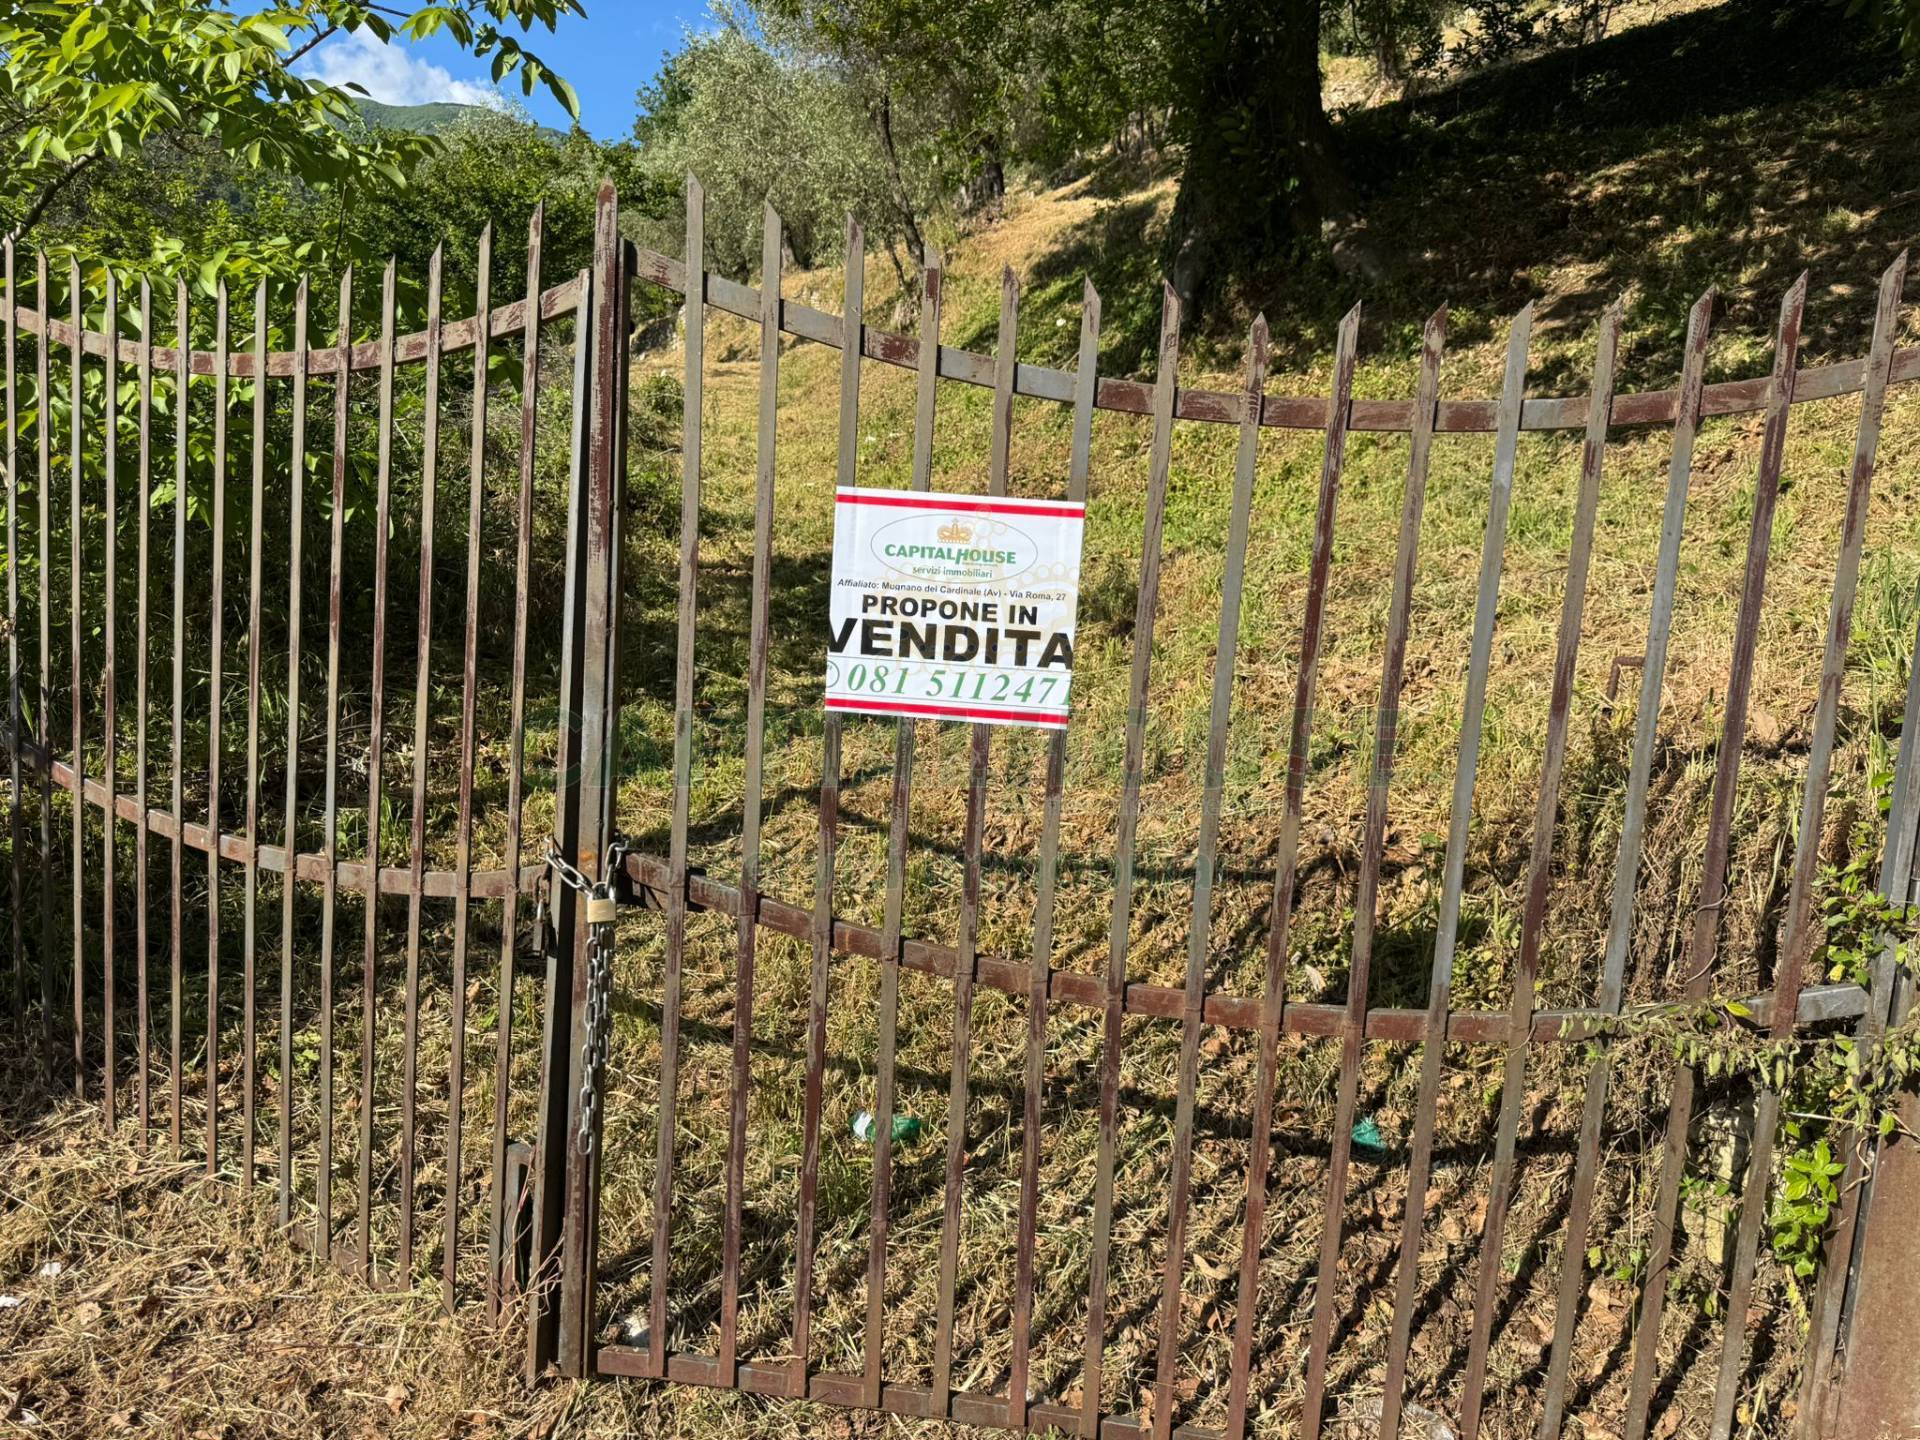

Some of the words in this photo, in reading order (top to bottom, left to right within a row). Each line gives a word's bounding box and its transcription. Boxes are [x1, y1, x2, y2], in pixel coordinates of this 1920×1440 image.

[884, 543, 1017, 565] CAPITALHOUSE
[912, 566, 941, 576] servizi
[943, 567, 993, 579] immobiliari
[881, 581, 922, 592] Mugnano
[939, 585, 981, 597] Cardinale
[983, 588, 1001, 598] (Av)
[1009, 590, 1023, 599] Via
[1025, 591, 1054, 602] Roma,
[1055, 593, 1066, 601] 27
[862, 594, 998, 623] PROPONE
[1008, 604, 1038, 626] IN
[829, 617, 1073, 670] VENDITA
[847, 663, 908, 695] 081
